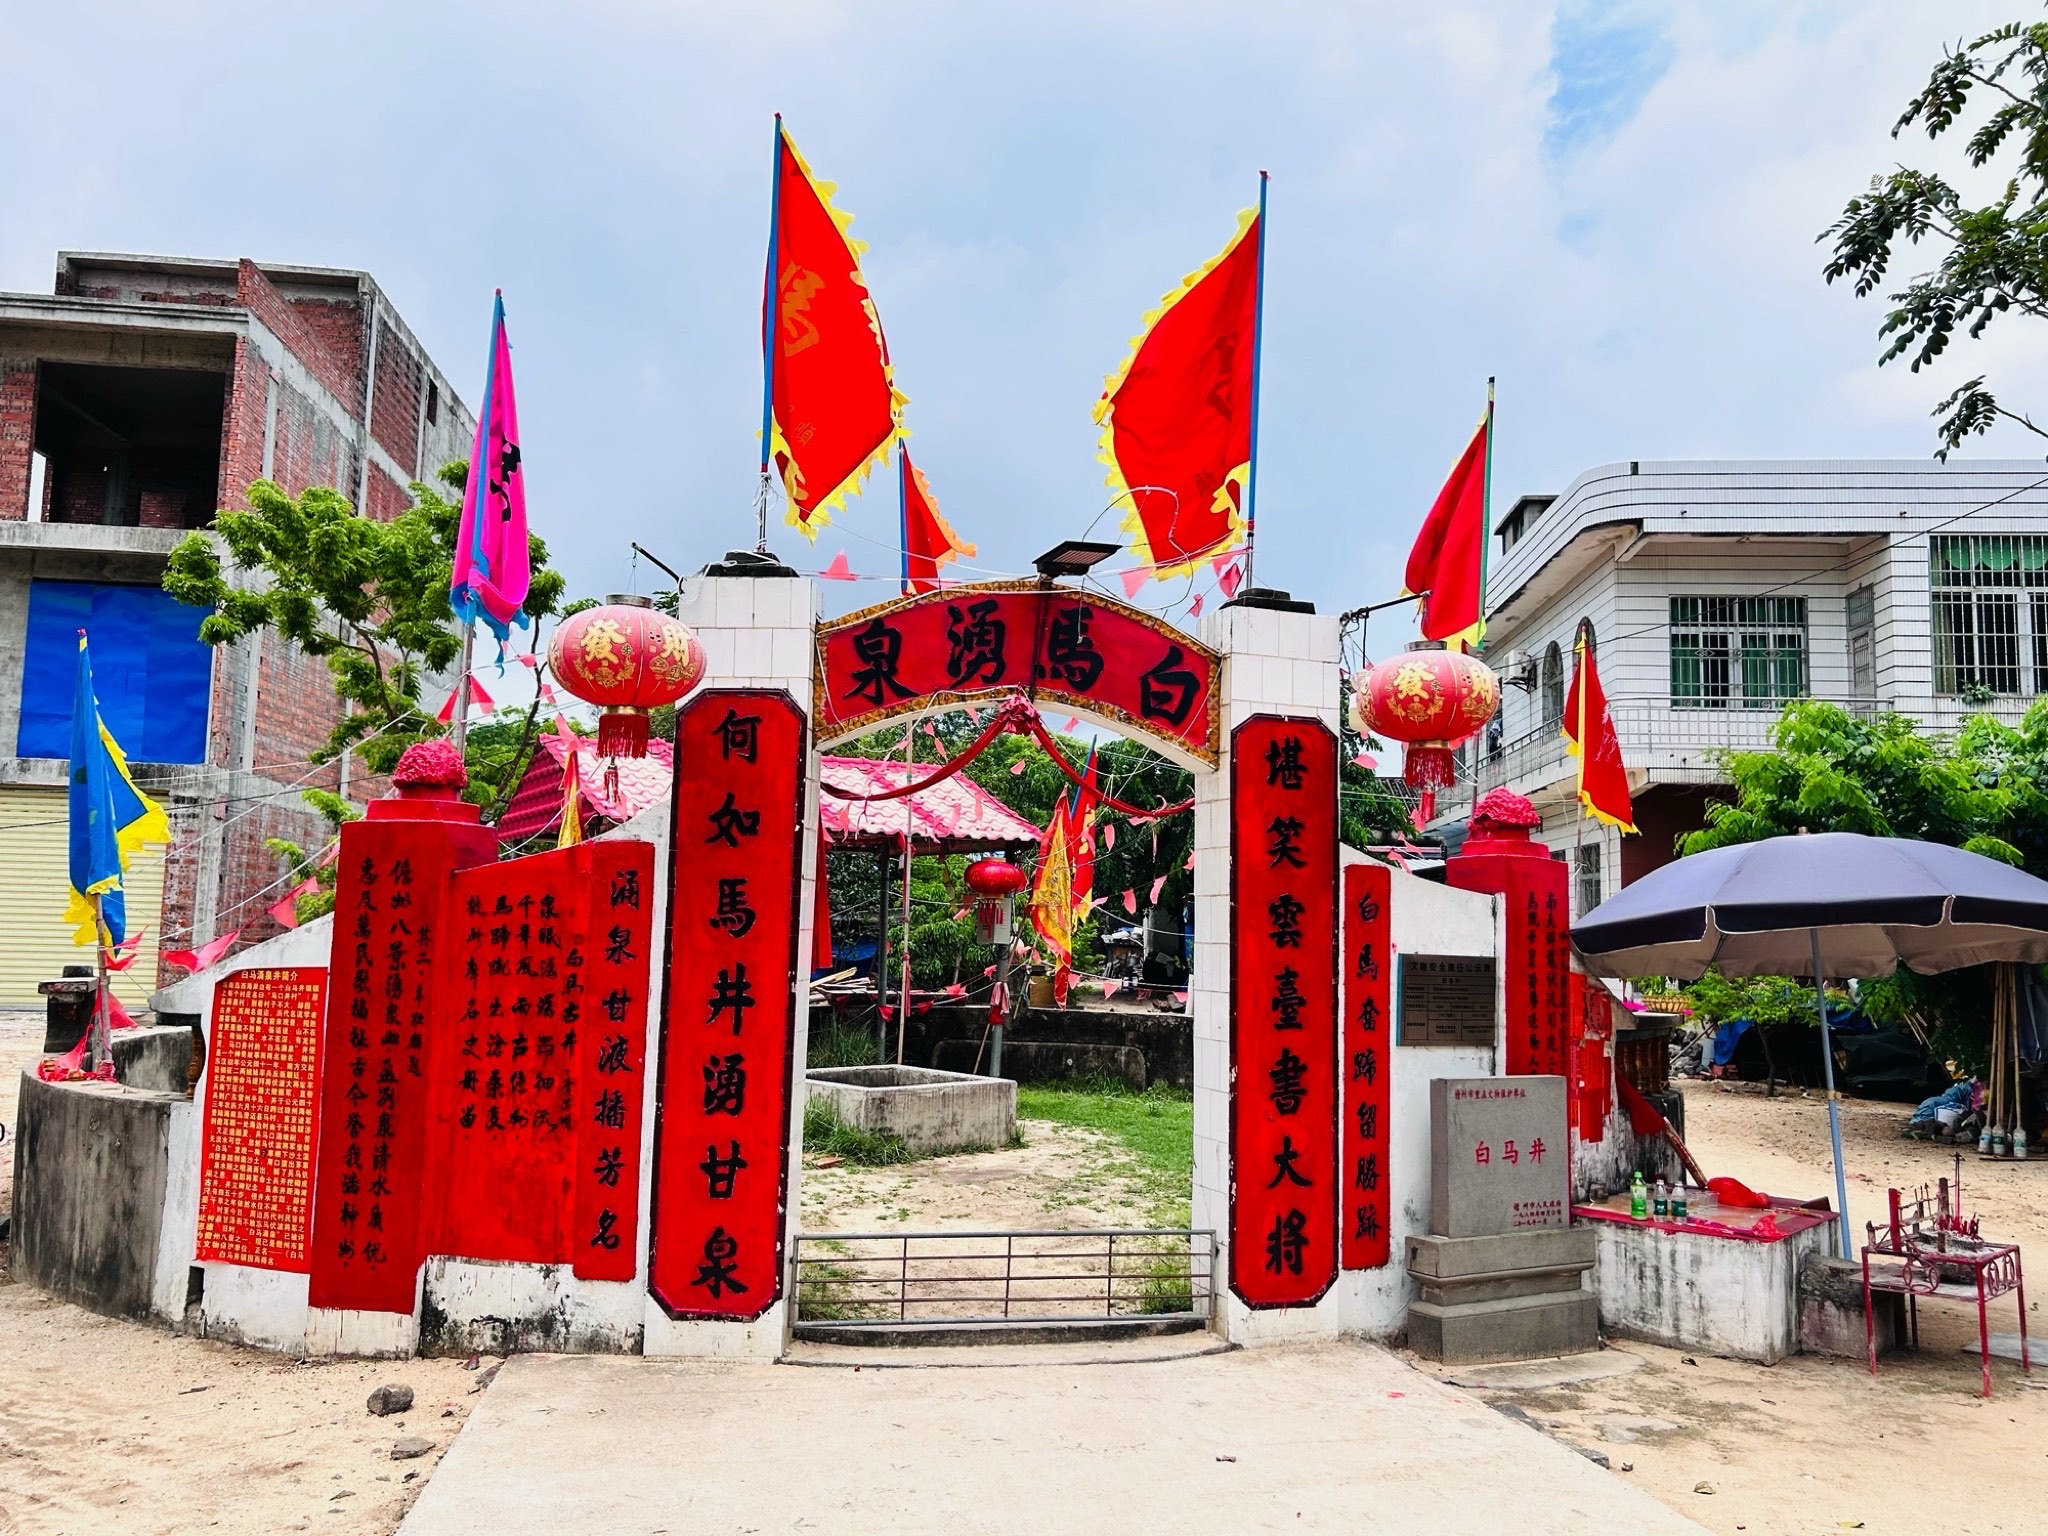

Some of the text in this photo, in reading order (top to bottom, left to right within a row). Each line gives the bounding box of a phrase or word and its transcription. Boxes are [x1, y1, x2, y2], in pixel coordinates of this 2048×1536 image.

[241, 970, 298, 982] 白马涌泉井简介
[591, 870, 641, 1251] 涌泉甘液播芳名
[690, 708, 763, 1299] 何如馬井湧甘泉
[1266, 738, 1313, 1276] 堪笑雲臺書大將
[1475, 1137, 1546, 1165] 白马井
